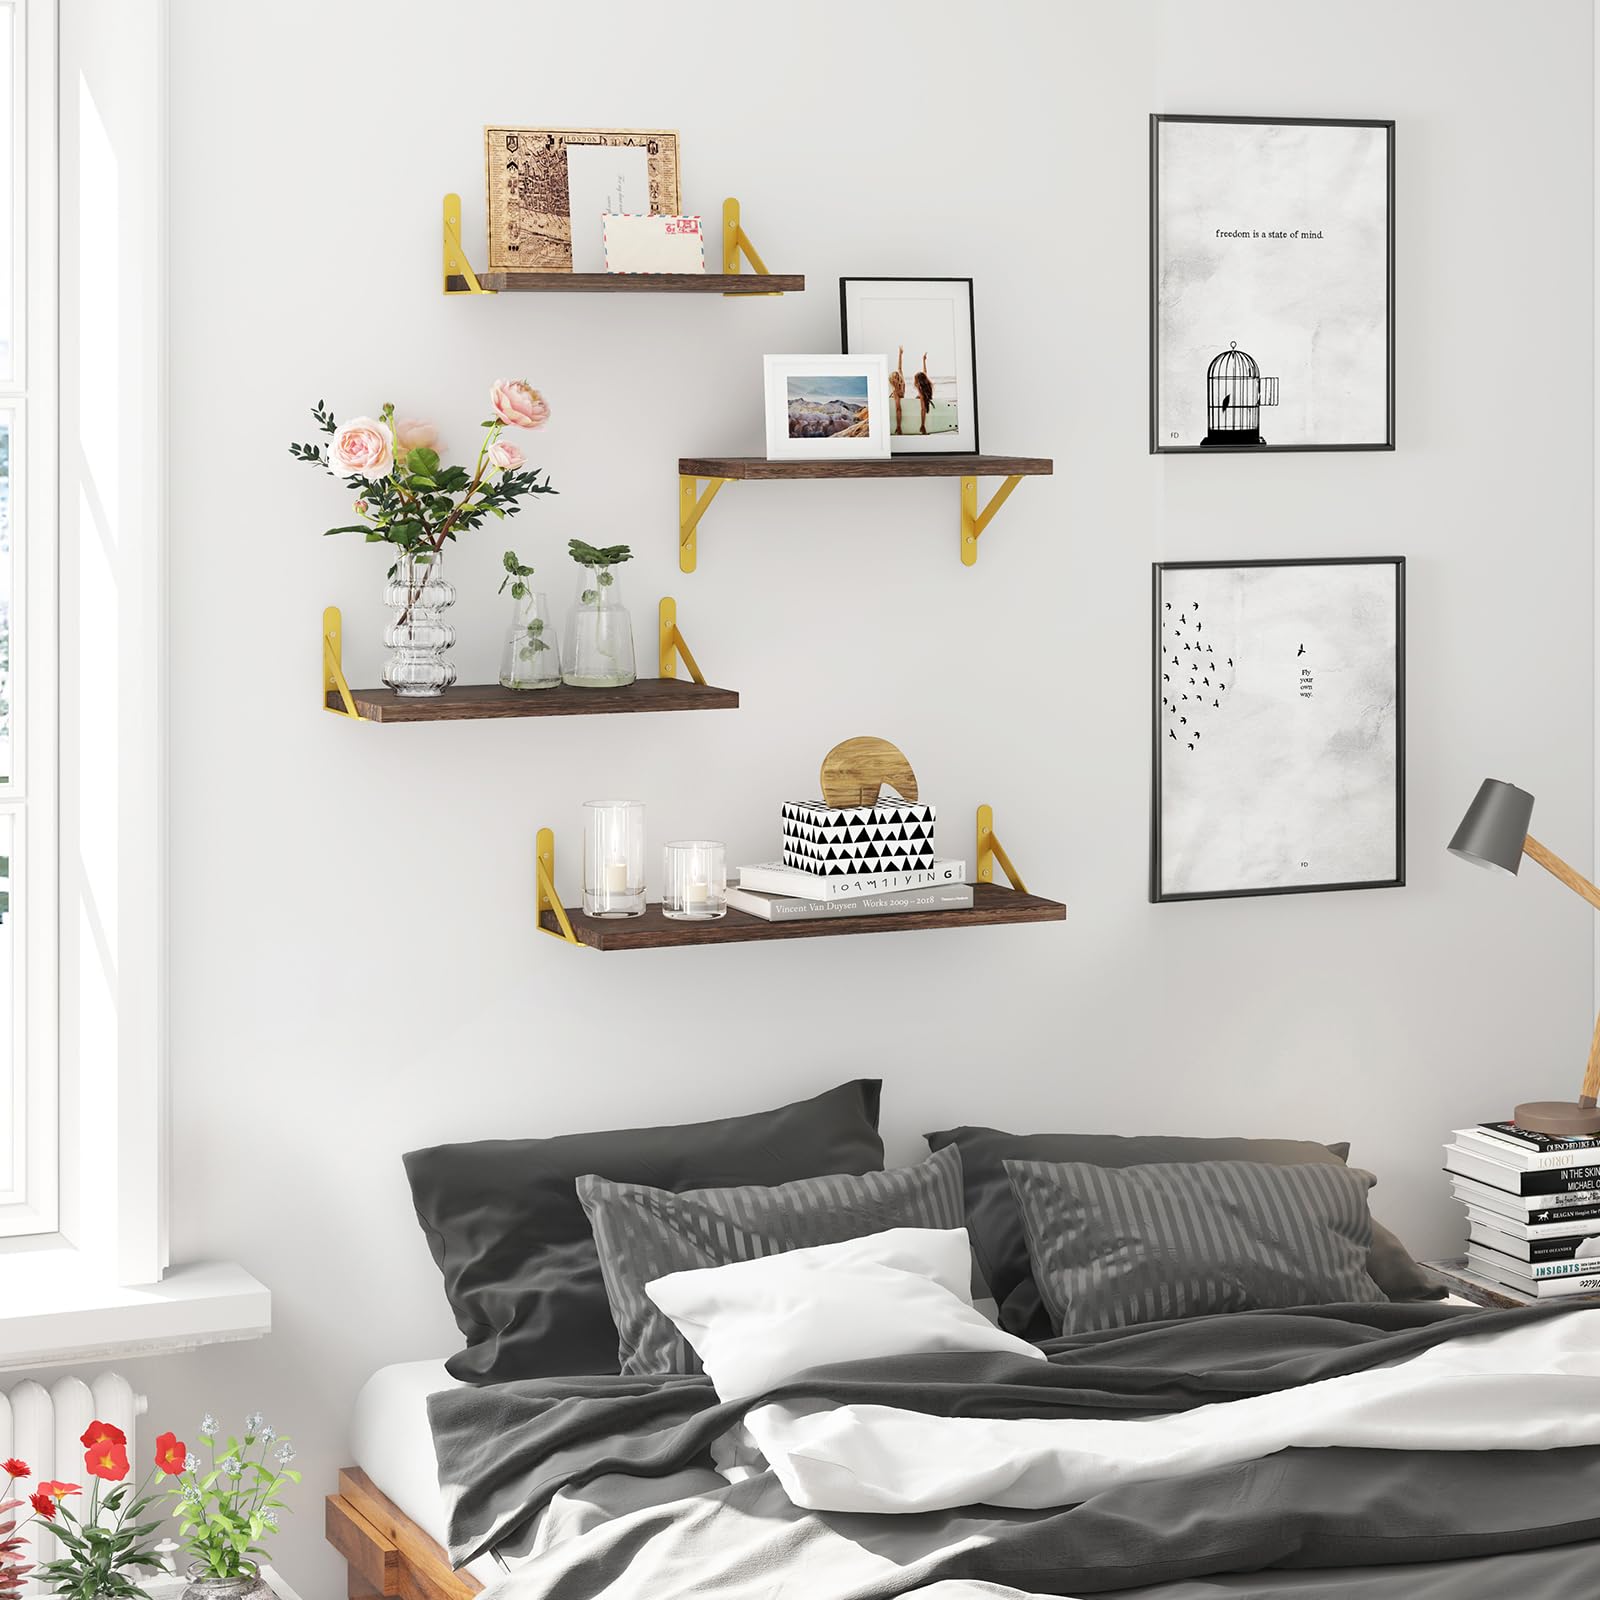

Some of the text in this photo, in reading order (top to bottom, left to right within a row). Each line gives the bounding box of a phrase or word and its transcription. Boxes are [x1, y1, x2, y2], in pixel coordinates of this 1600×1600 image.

[1215, 229, 1250, 238] freedom
[1253, 229, 1259, 238] is
[1268, 230, 1287, 238] state
[1290, 230, 1299, 238] of
[1300, 230, 1324, 239] mind.
[776, 905, 807, 913] Vincent
[809, 903, 824, 911] Van
[826, 902, 857, 912] Duysen
[862, 899, 888, 908] Works
[889, 899, 909, 907] 2009
[916, 896, 935, 904] 2018
[1560, 1167, 1600, 1180] IN THE SKIN
[1567, 1180, 1595, 1191] MICHAEL
[1536, 1263, 1580, 1276] INSIGHTS
